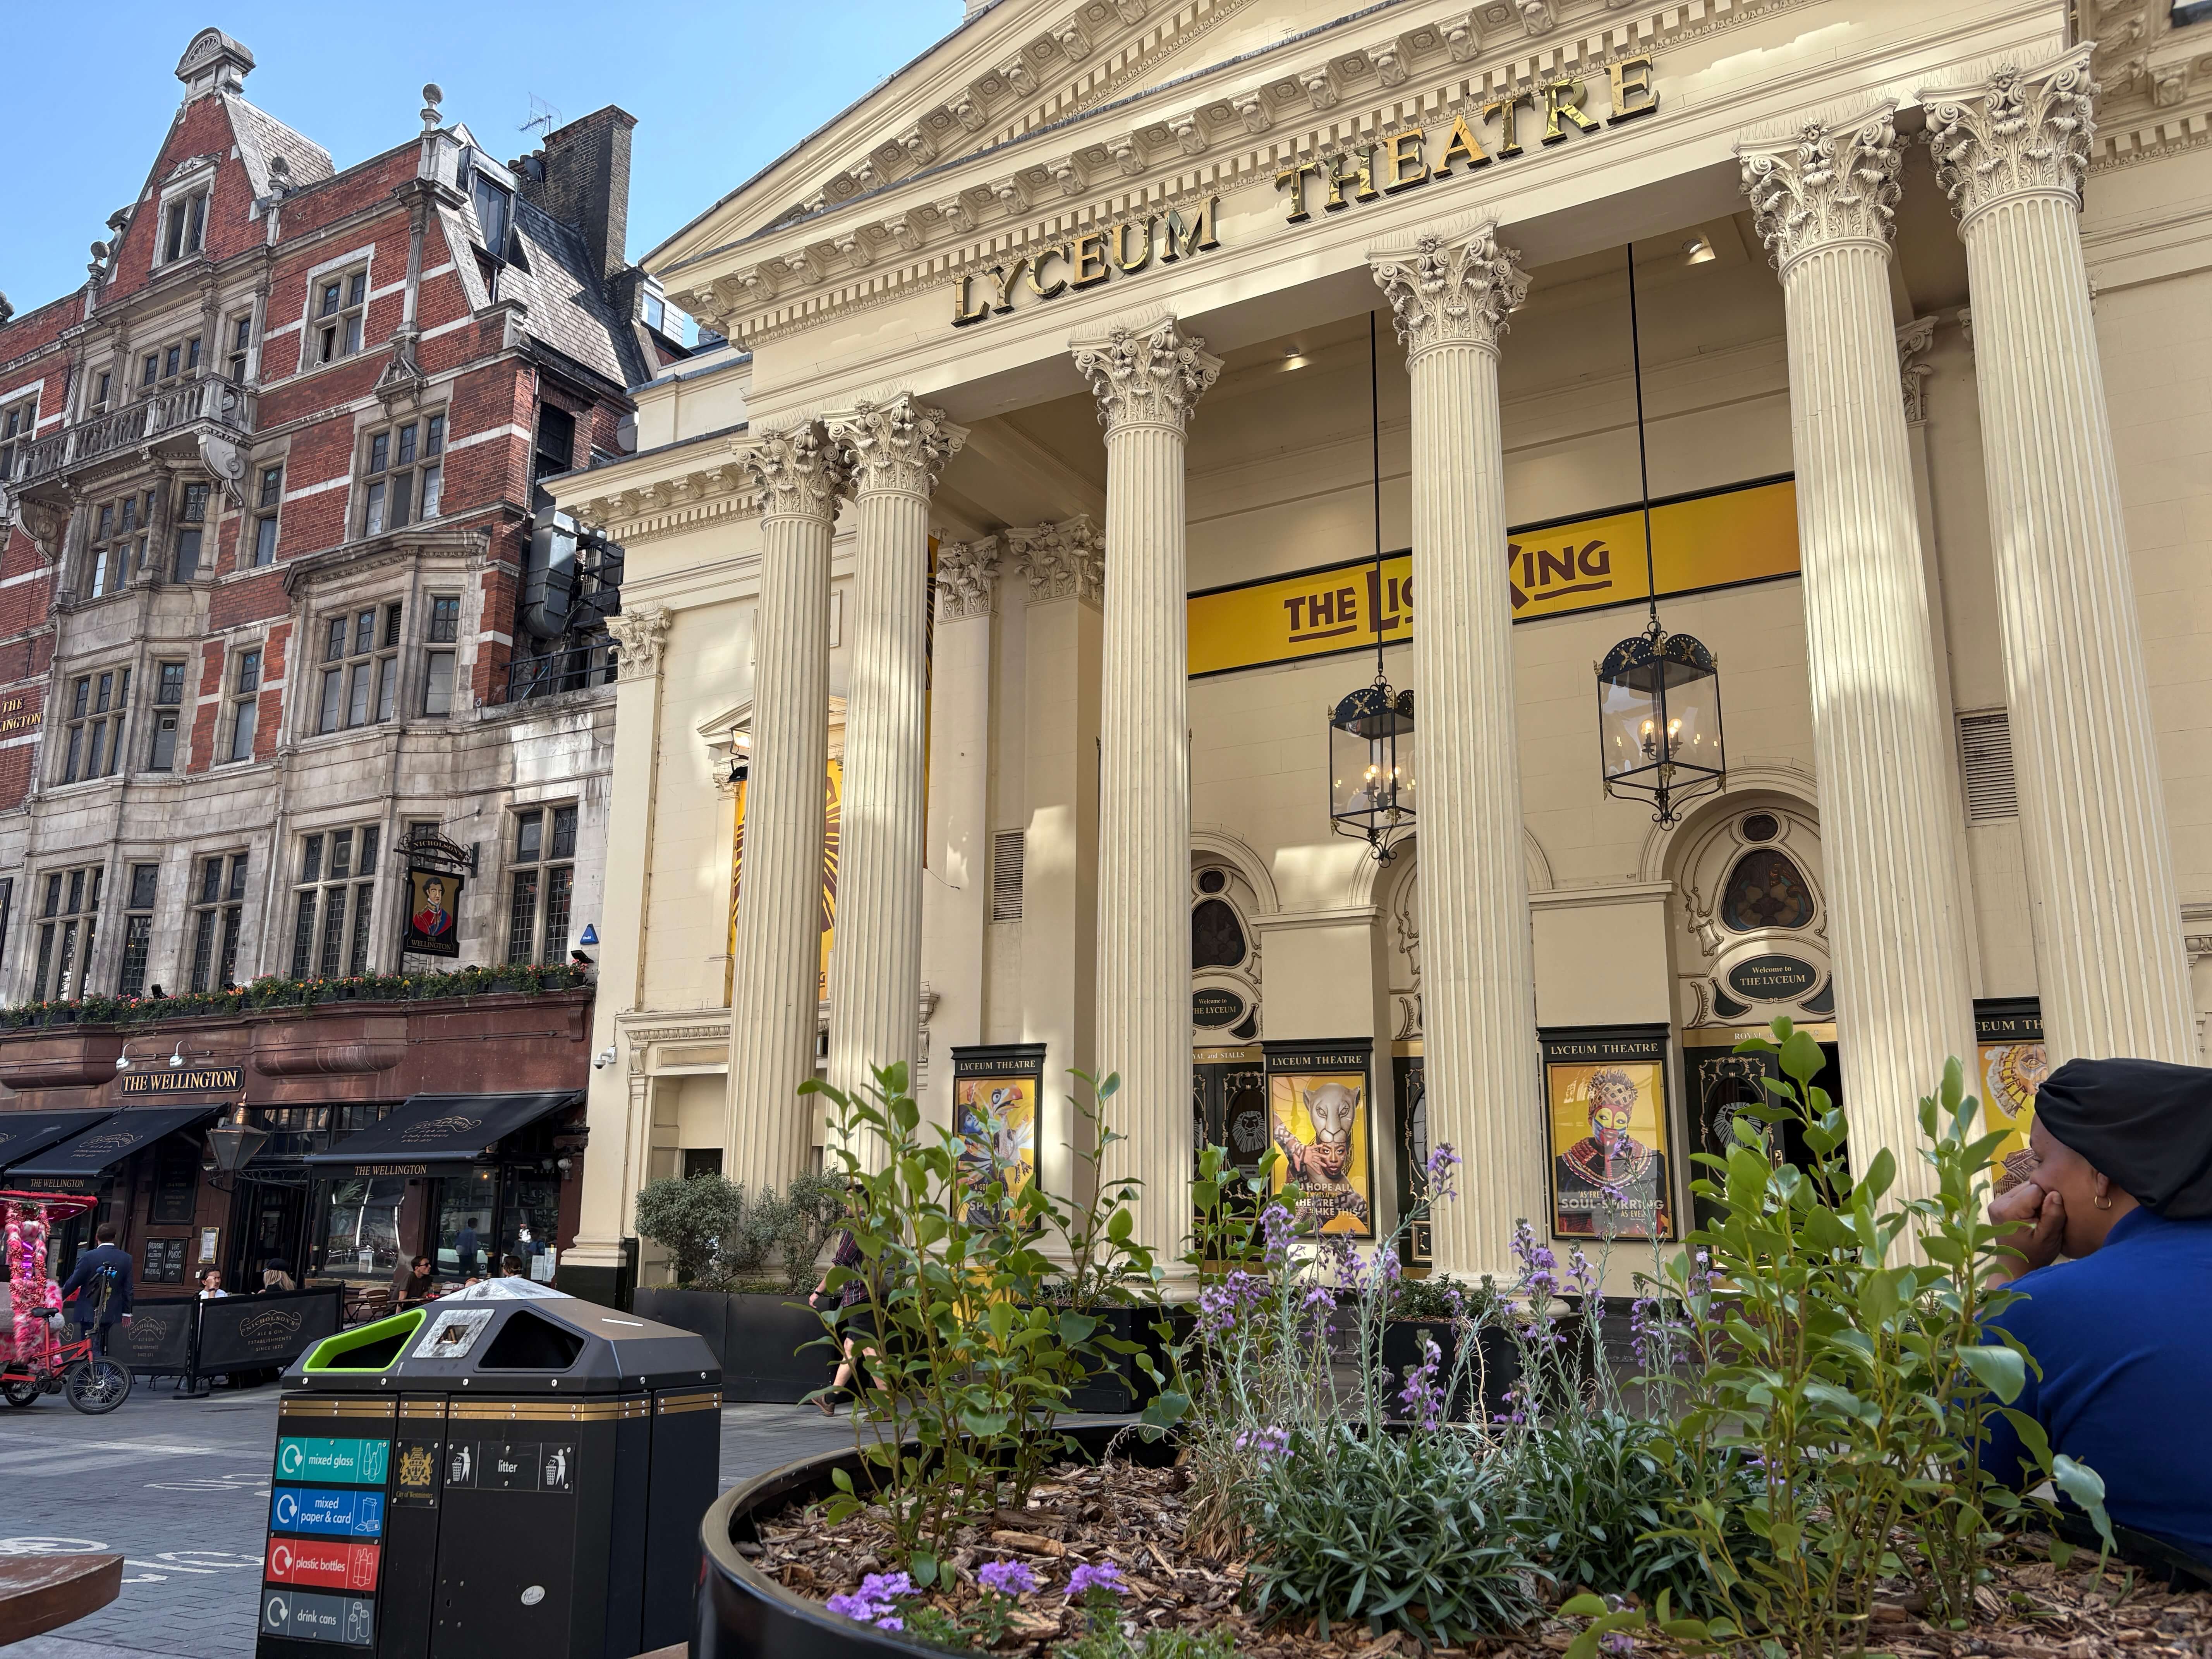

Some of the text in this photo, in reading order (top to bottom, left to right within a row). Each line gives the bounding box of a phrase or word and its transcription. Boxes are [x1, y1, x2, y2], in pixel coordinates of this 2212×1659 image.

[951, 53, 1661, 328] LYCEUM THEATRE
[1284, 586, 1357, 631] THE
[2, 698, 23, 713] THE
[0, 712, 42, 732] INGTON
[411, 939, 451, 950] WELLINGTON
[1740, 974, 1806, 986] THE LYCEUM
[1975, 1021, 2015, 1031] CEUM
[1551, 1043, 1658, 1054] LYCEUM THEATRE
[960, 1060, 1036, 1070] LYCEUM THEATRE
[1272, 1055, 1362, 1066] LYCEUM THEATRE
[123, 1070, 238, 1092] THE WELLINGTON
[355, 1164, 427, 1175] THE WELLINGTON
[31, 1178, 85, 1188] THE WELLINGTON
[1306, 1183, 1333, 1191] HOPE
[246, 1316, 297, 1331] NICHOLSON'S
[248, 1336, 292, 1345] ESTABLISHMENTS
[308, 1453, 354, 1469] mixed glass
[498, 1459, 518, 1473] litter
[314, 1496, 339, 1509] mixed
[301, 1510, 352, 1525] paper & card
[295, 1556, 345, 1572] plastic bottles
[297, 1609, 337, 1626] drink cans
